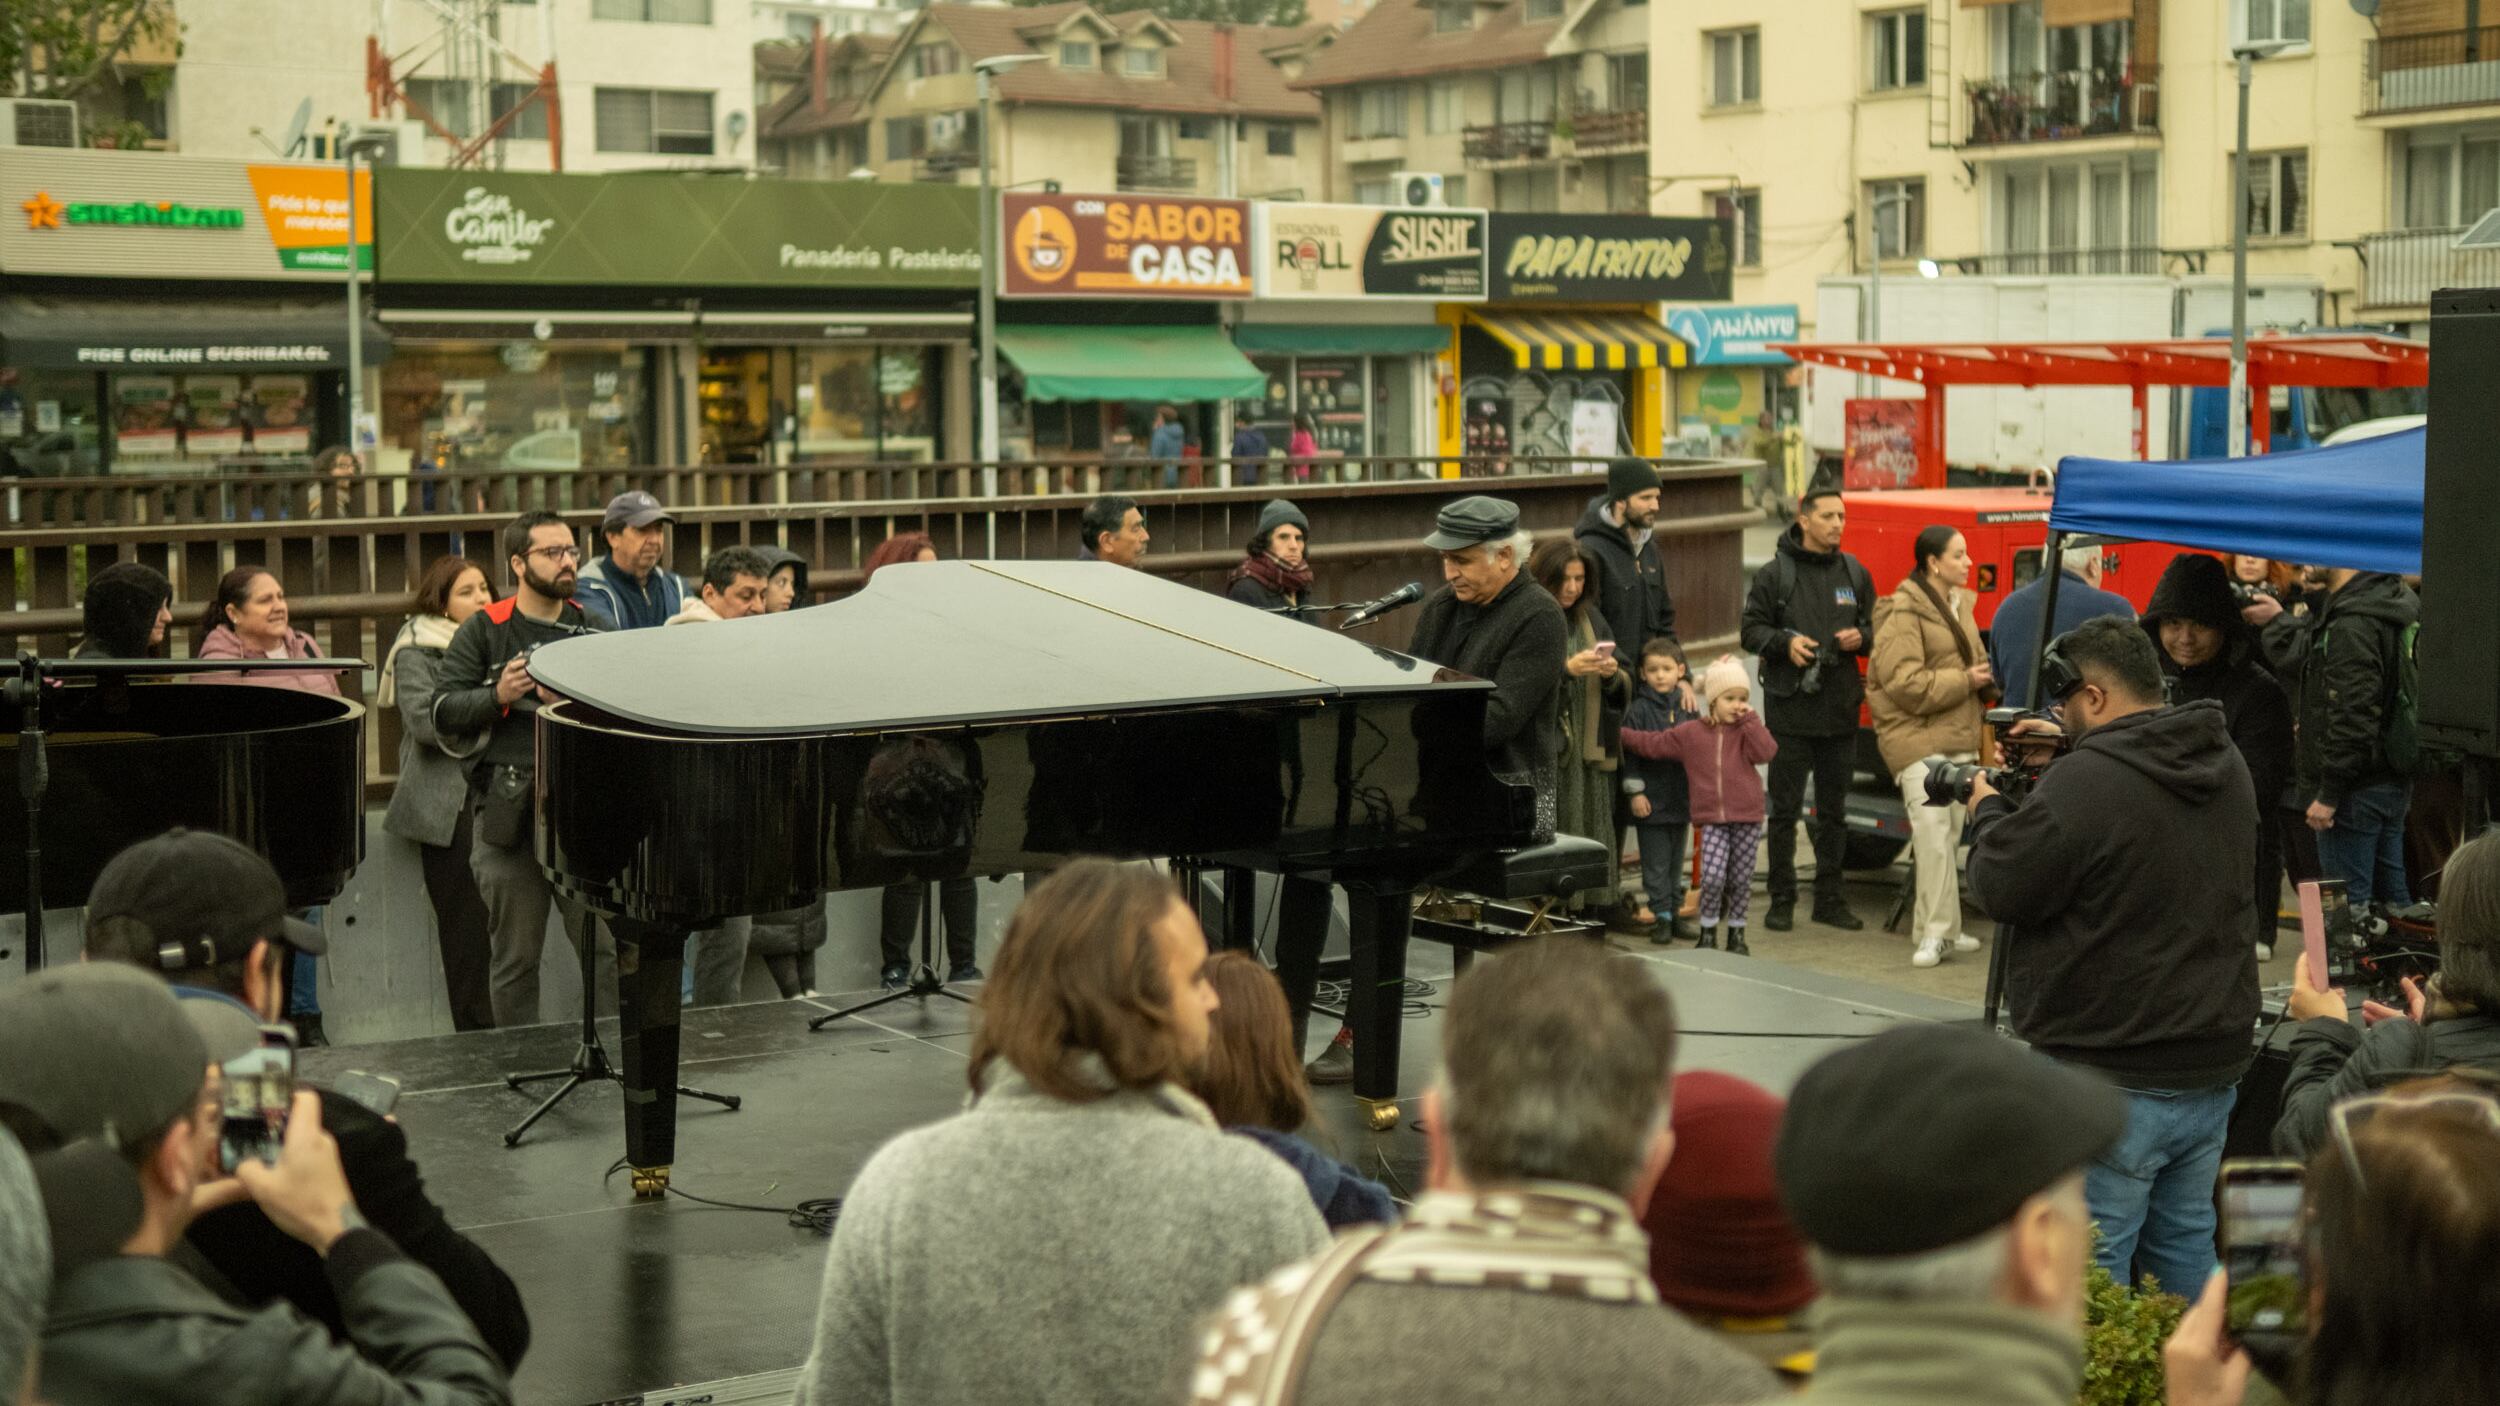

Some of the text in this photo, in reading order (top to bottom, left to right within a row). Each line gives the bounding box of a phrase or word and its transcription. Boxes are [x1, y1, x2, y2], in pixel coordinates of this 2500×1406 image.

[464, 186, 512, 213] San
[1074, 200, 1106, 216] CON
[67, 201, 244, 229] sushiban
[445, 206, 555, 245] Camilo
[1105, 201, 1243, 244] SABOR
[1105, 243, 1129, 260] DE
[1384, 215, 1482, 260] SUSHI
[780, 244, 983, 270] Panadería Pastelería
[1129, 243, 1243, 286] CASA
[1277, 239, 1353, 270] ROLL
[77, 345, 330, 363] PIDE ONLINE SUSHIBAN.CL
